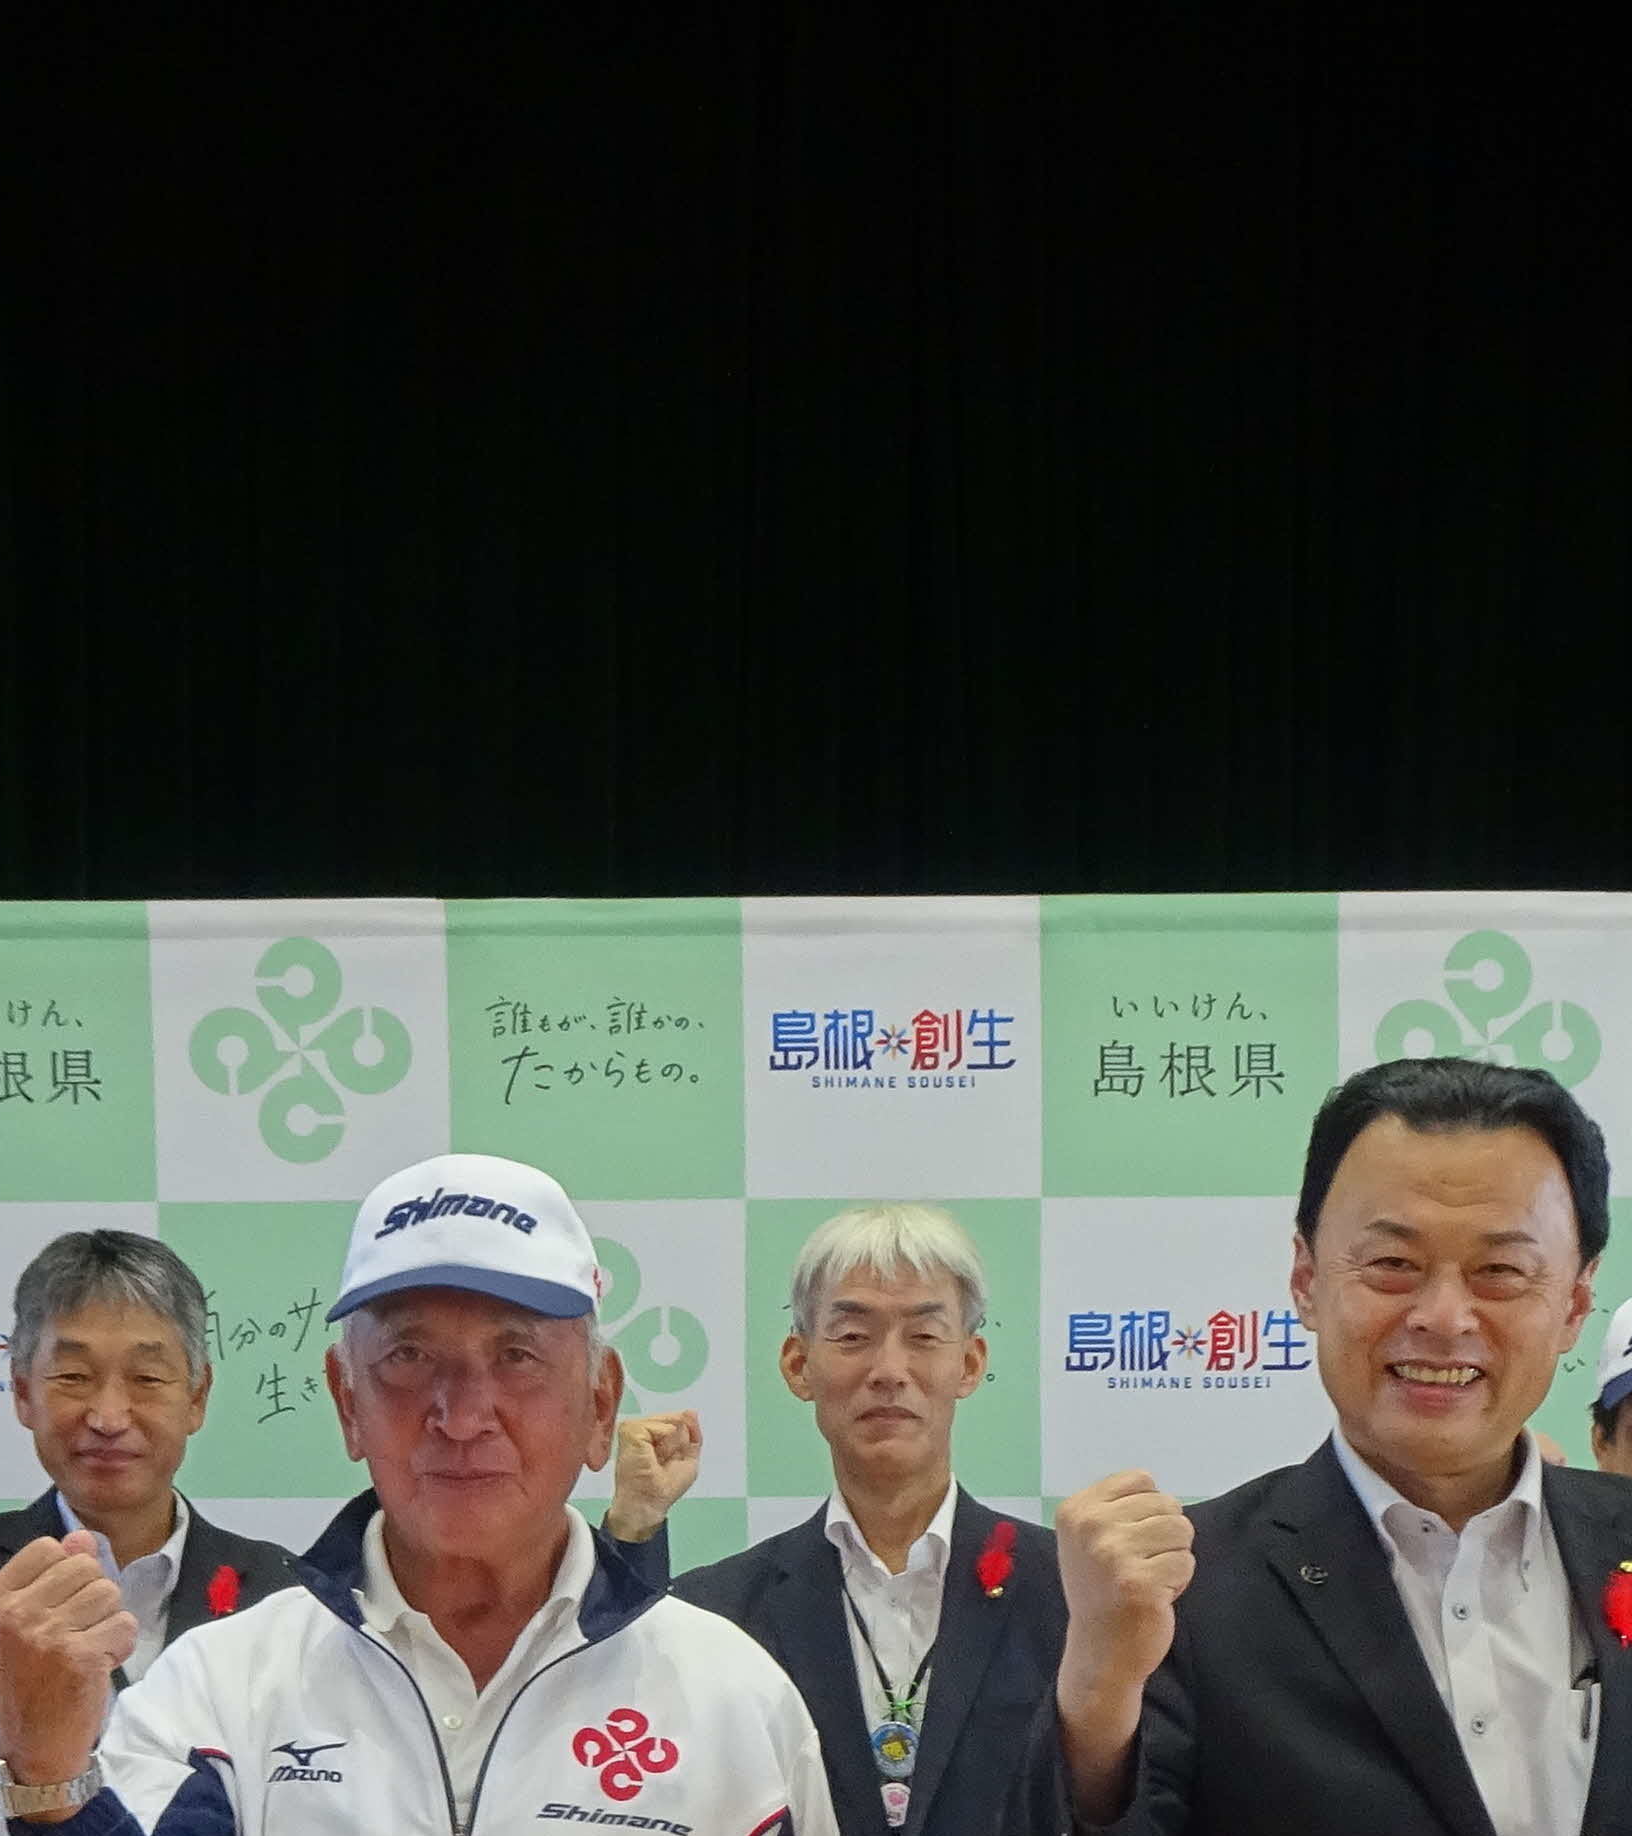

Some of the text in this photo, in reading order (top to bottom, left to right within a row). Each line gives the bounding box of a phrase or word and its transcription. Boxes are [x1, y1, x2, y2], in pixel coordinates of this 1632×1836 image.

[1112, 992, 1268, 1021] いいけん、
[501, 1046, 700, 1105] たからもの。
[812, 1076, 976, 1089] SHIMANE SOUSEI
[1093, 1040, 1285, 1099] 島根県
[374, 1187, 538, 1240] Shimane
[256, 1363, 318, 1424] 生き
[1108, 1376, 1271, 1389] SHIMANE SOUSEI
